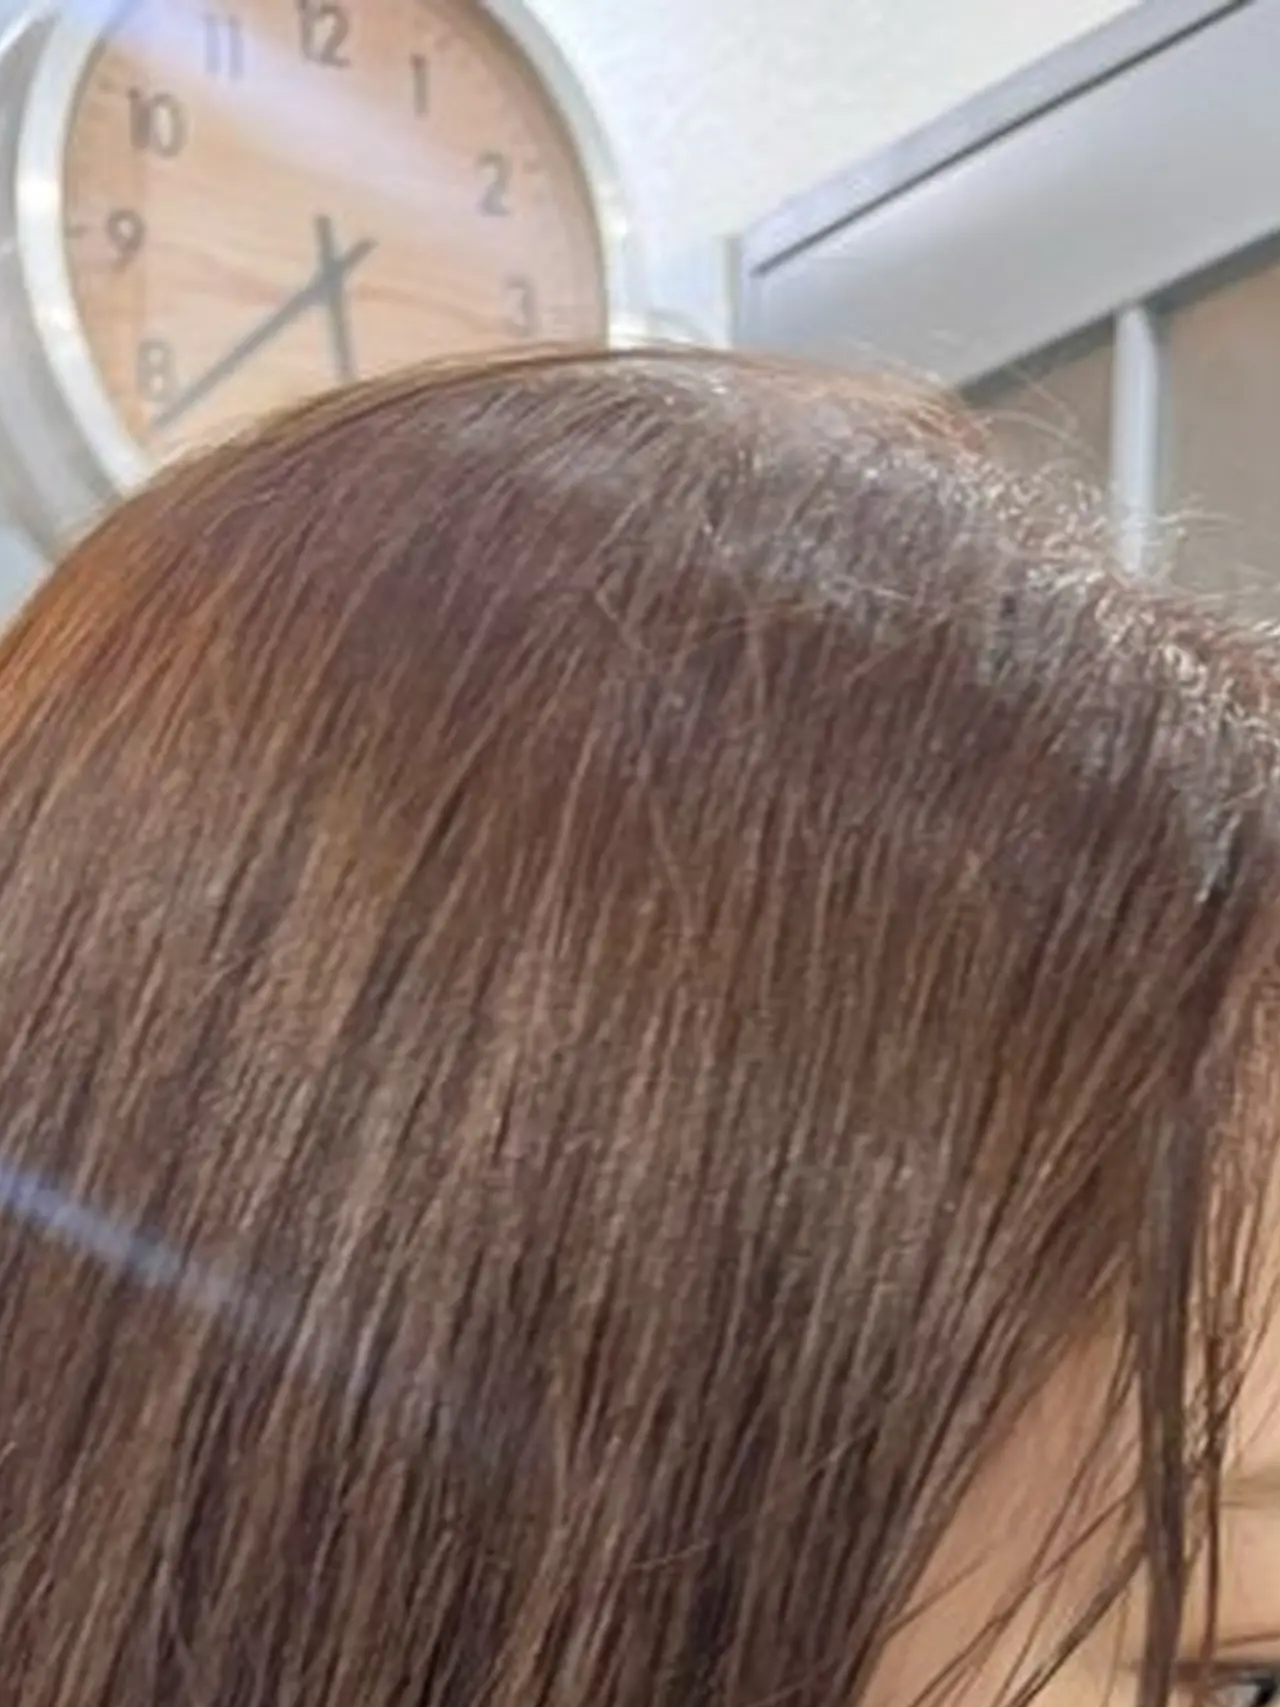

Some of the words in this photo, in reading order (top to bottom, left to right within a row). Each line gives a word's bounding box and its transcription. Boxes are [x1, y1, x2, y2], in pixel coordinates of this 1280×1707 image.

[204, 13, 243, 80] 11
[295, 0, 351, 68] 12
[410, 54, 427, 117] 1
[127, 87, 187, 158] 10
[477, 151, 510, 216] 2
[106, 210, 145, 270] 9
[505, 275, 537, 338] 3
[137, 338, 174, 402] 8
